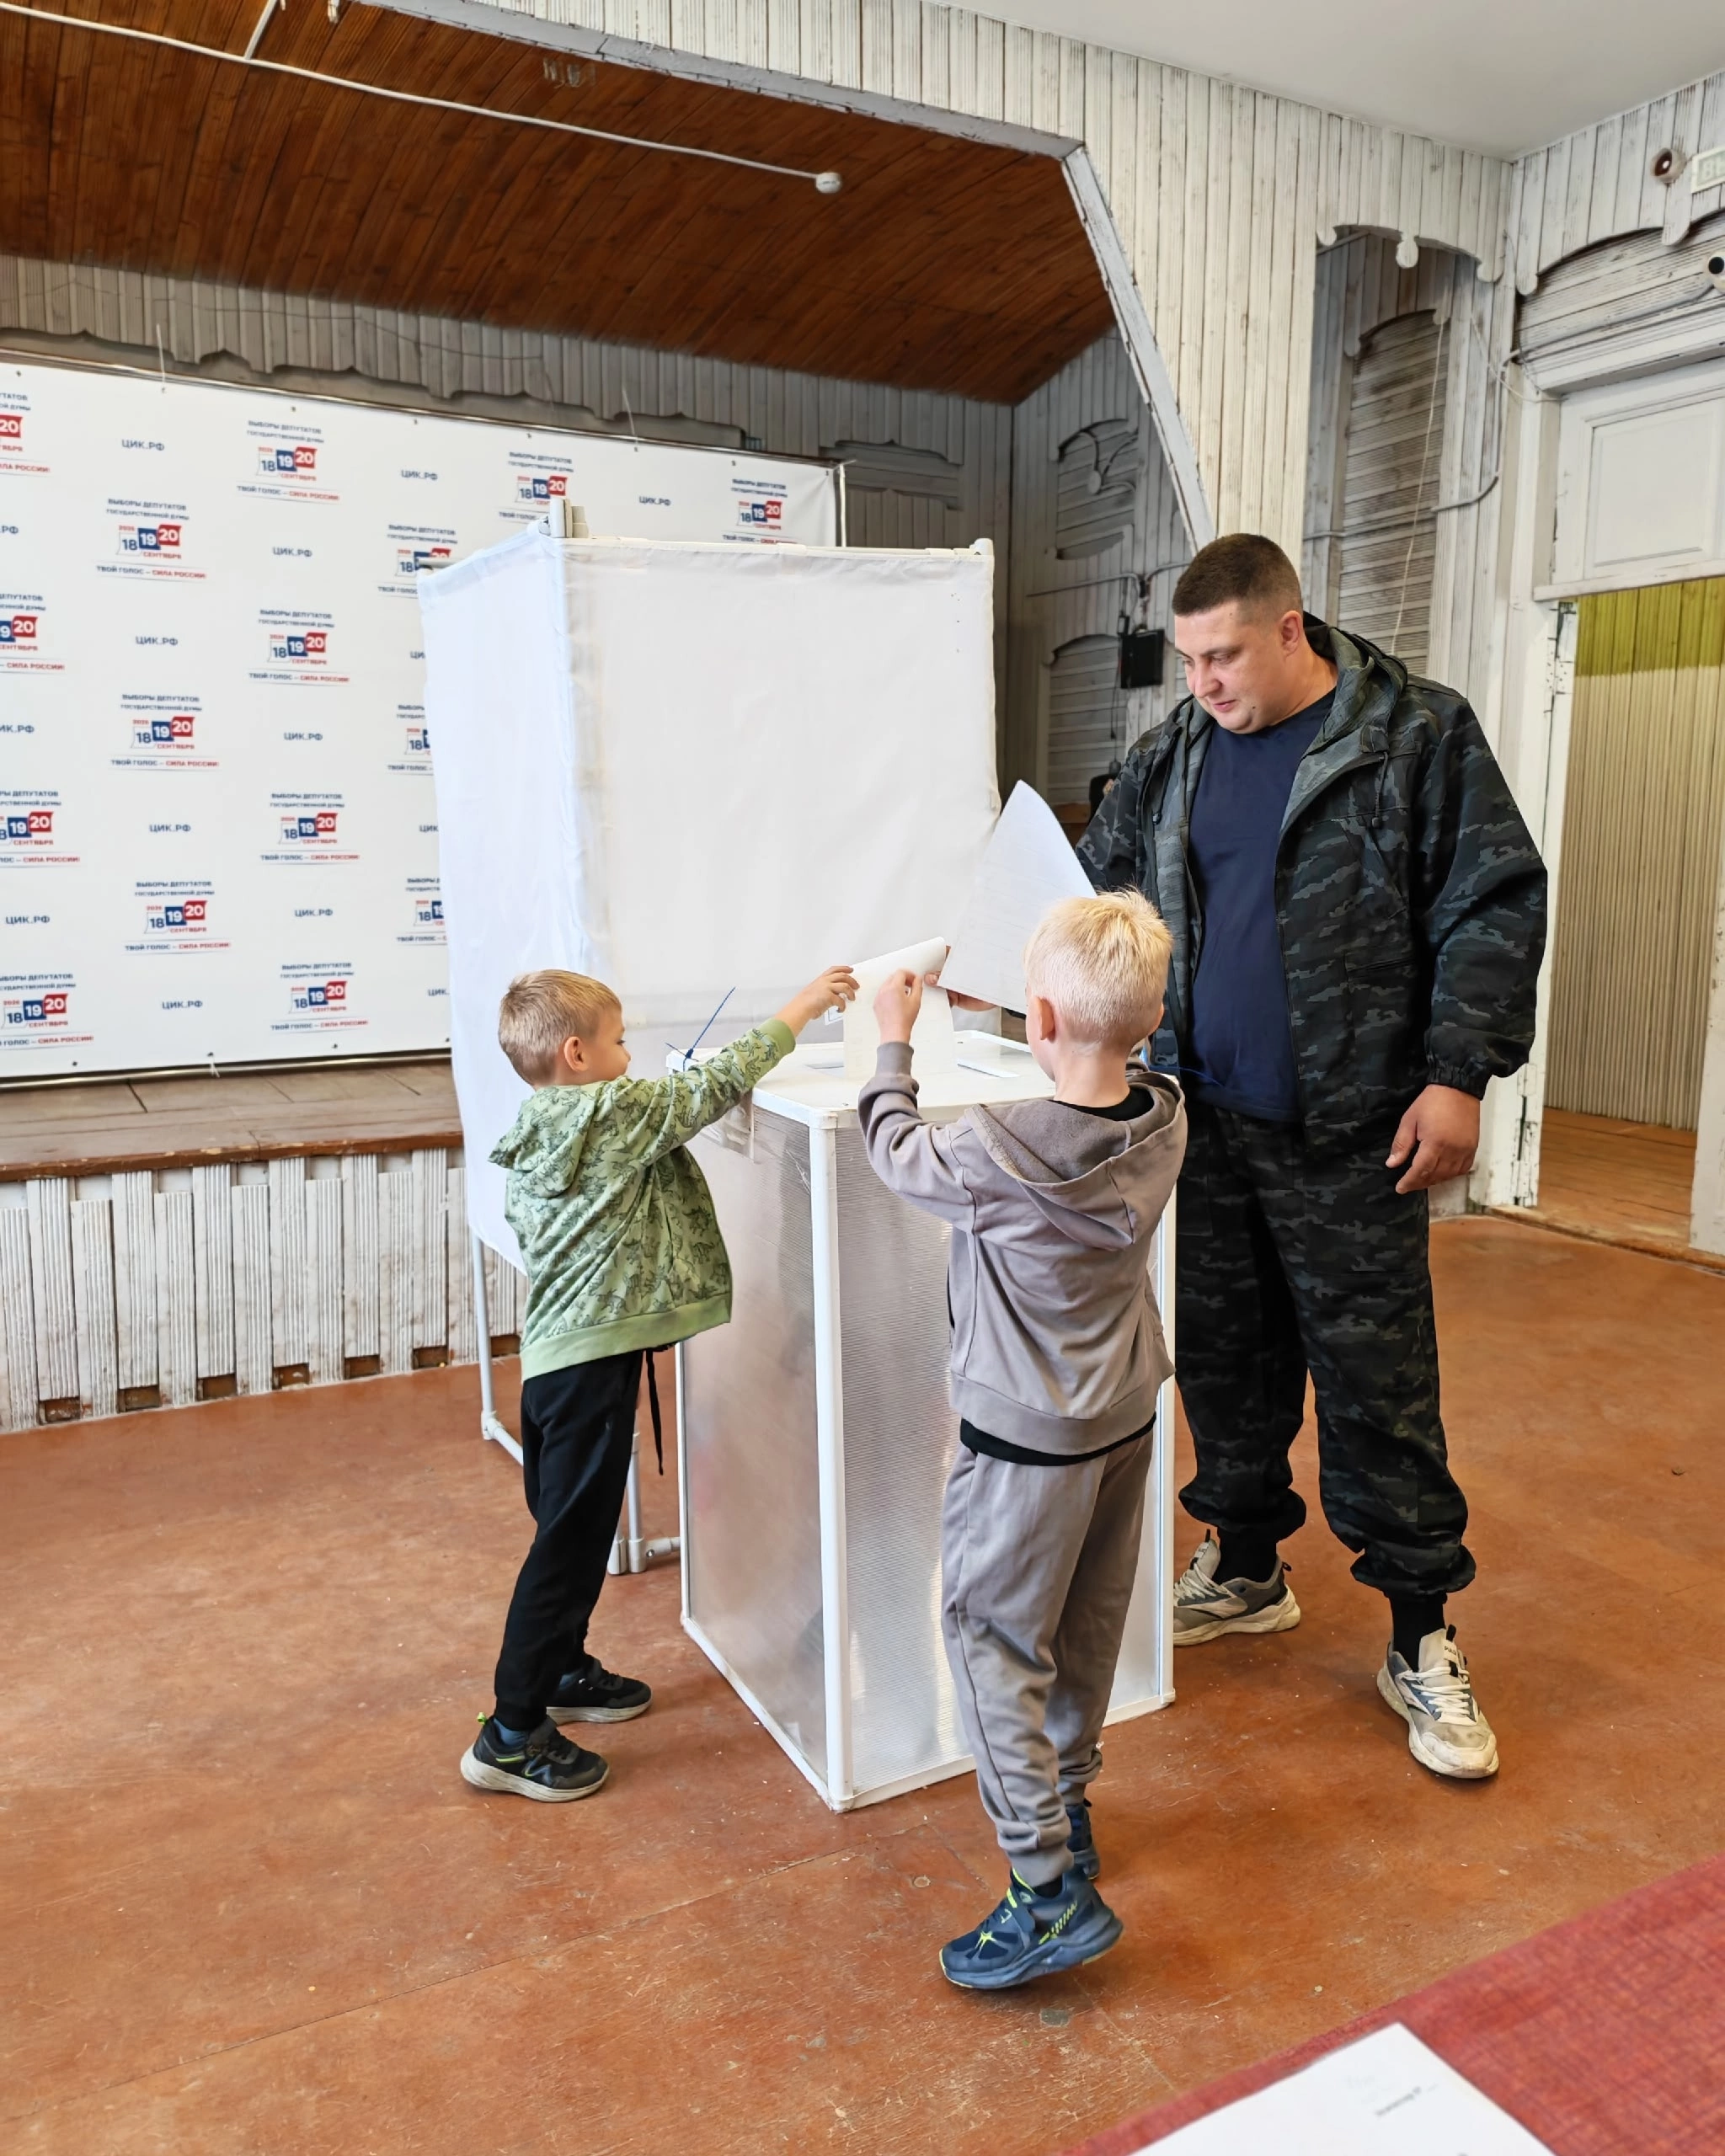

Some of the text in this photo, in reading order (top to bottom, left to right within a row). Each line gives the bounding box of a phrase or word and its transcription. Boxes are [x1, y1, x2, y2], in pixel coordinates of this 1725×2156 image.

[0, 419, 19, 434] 20
[122, 440, 165, 451] ЦИК.РФ
[261, 451, 313, 471] 18 19 20
[402, 470, 438, 480] ЦИК.РФ
[520, 481, 563, 499] 18 19 20
[741, 506, 779, 522] 18 19 20
[122, 529, 177, 550] 18 19 20
[273, 547, 312, 557] ЦИК.РФ
[400, 562, 413, 572] 18
[13, 620, 34, 633] 20
[136, 636, 179, 645] ЦИК.РФ
[273, 637, 323, 658] 18 19 20
[136, 721, 191, 743] 18 19 20
[284, 733, 323, 741] ЦИК.РФ
[410, 740, 422, 750] 18
[10, 821, 26, 834] 19
[29, 815, 50, 828] 20
[149, 825, 191, 833] ЦИК.РФ
[284, 817, 334, 839] 18 19 20
[150, 905, 203, 929] 18 19 20
[295, 909, 334, 917] ЦИК.РФ
[419, 911, 431, 921] 18
[6, 915, 50, 925] ЦИК.РФ
[294, 985, 344, 1008] 18 19 20
[7, 998, 64, 1023] 18 19 20
[162, 1001, 203, 1009] ЦИК.РФ
